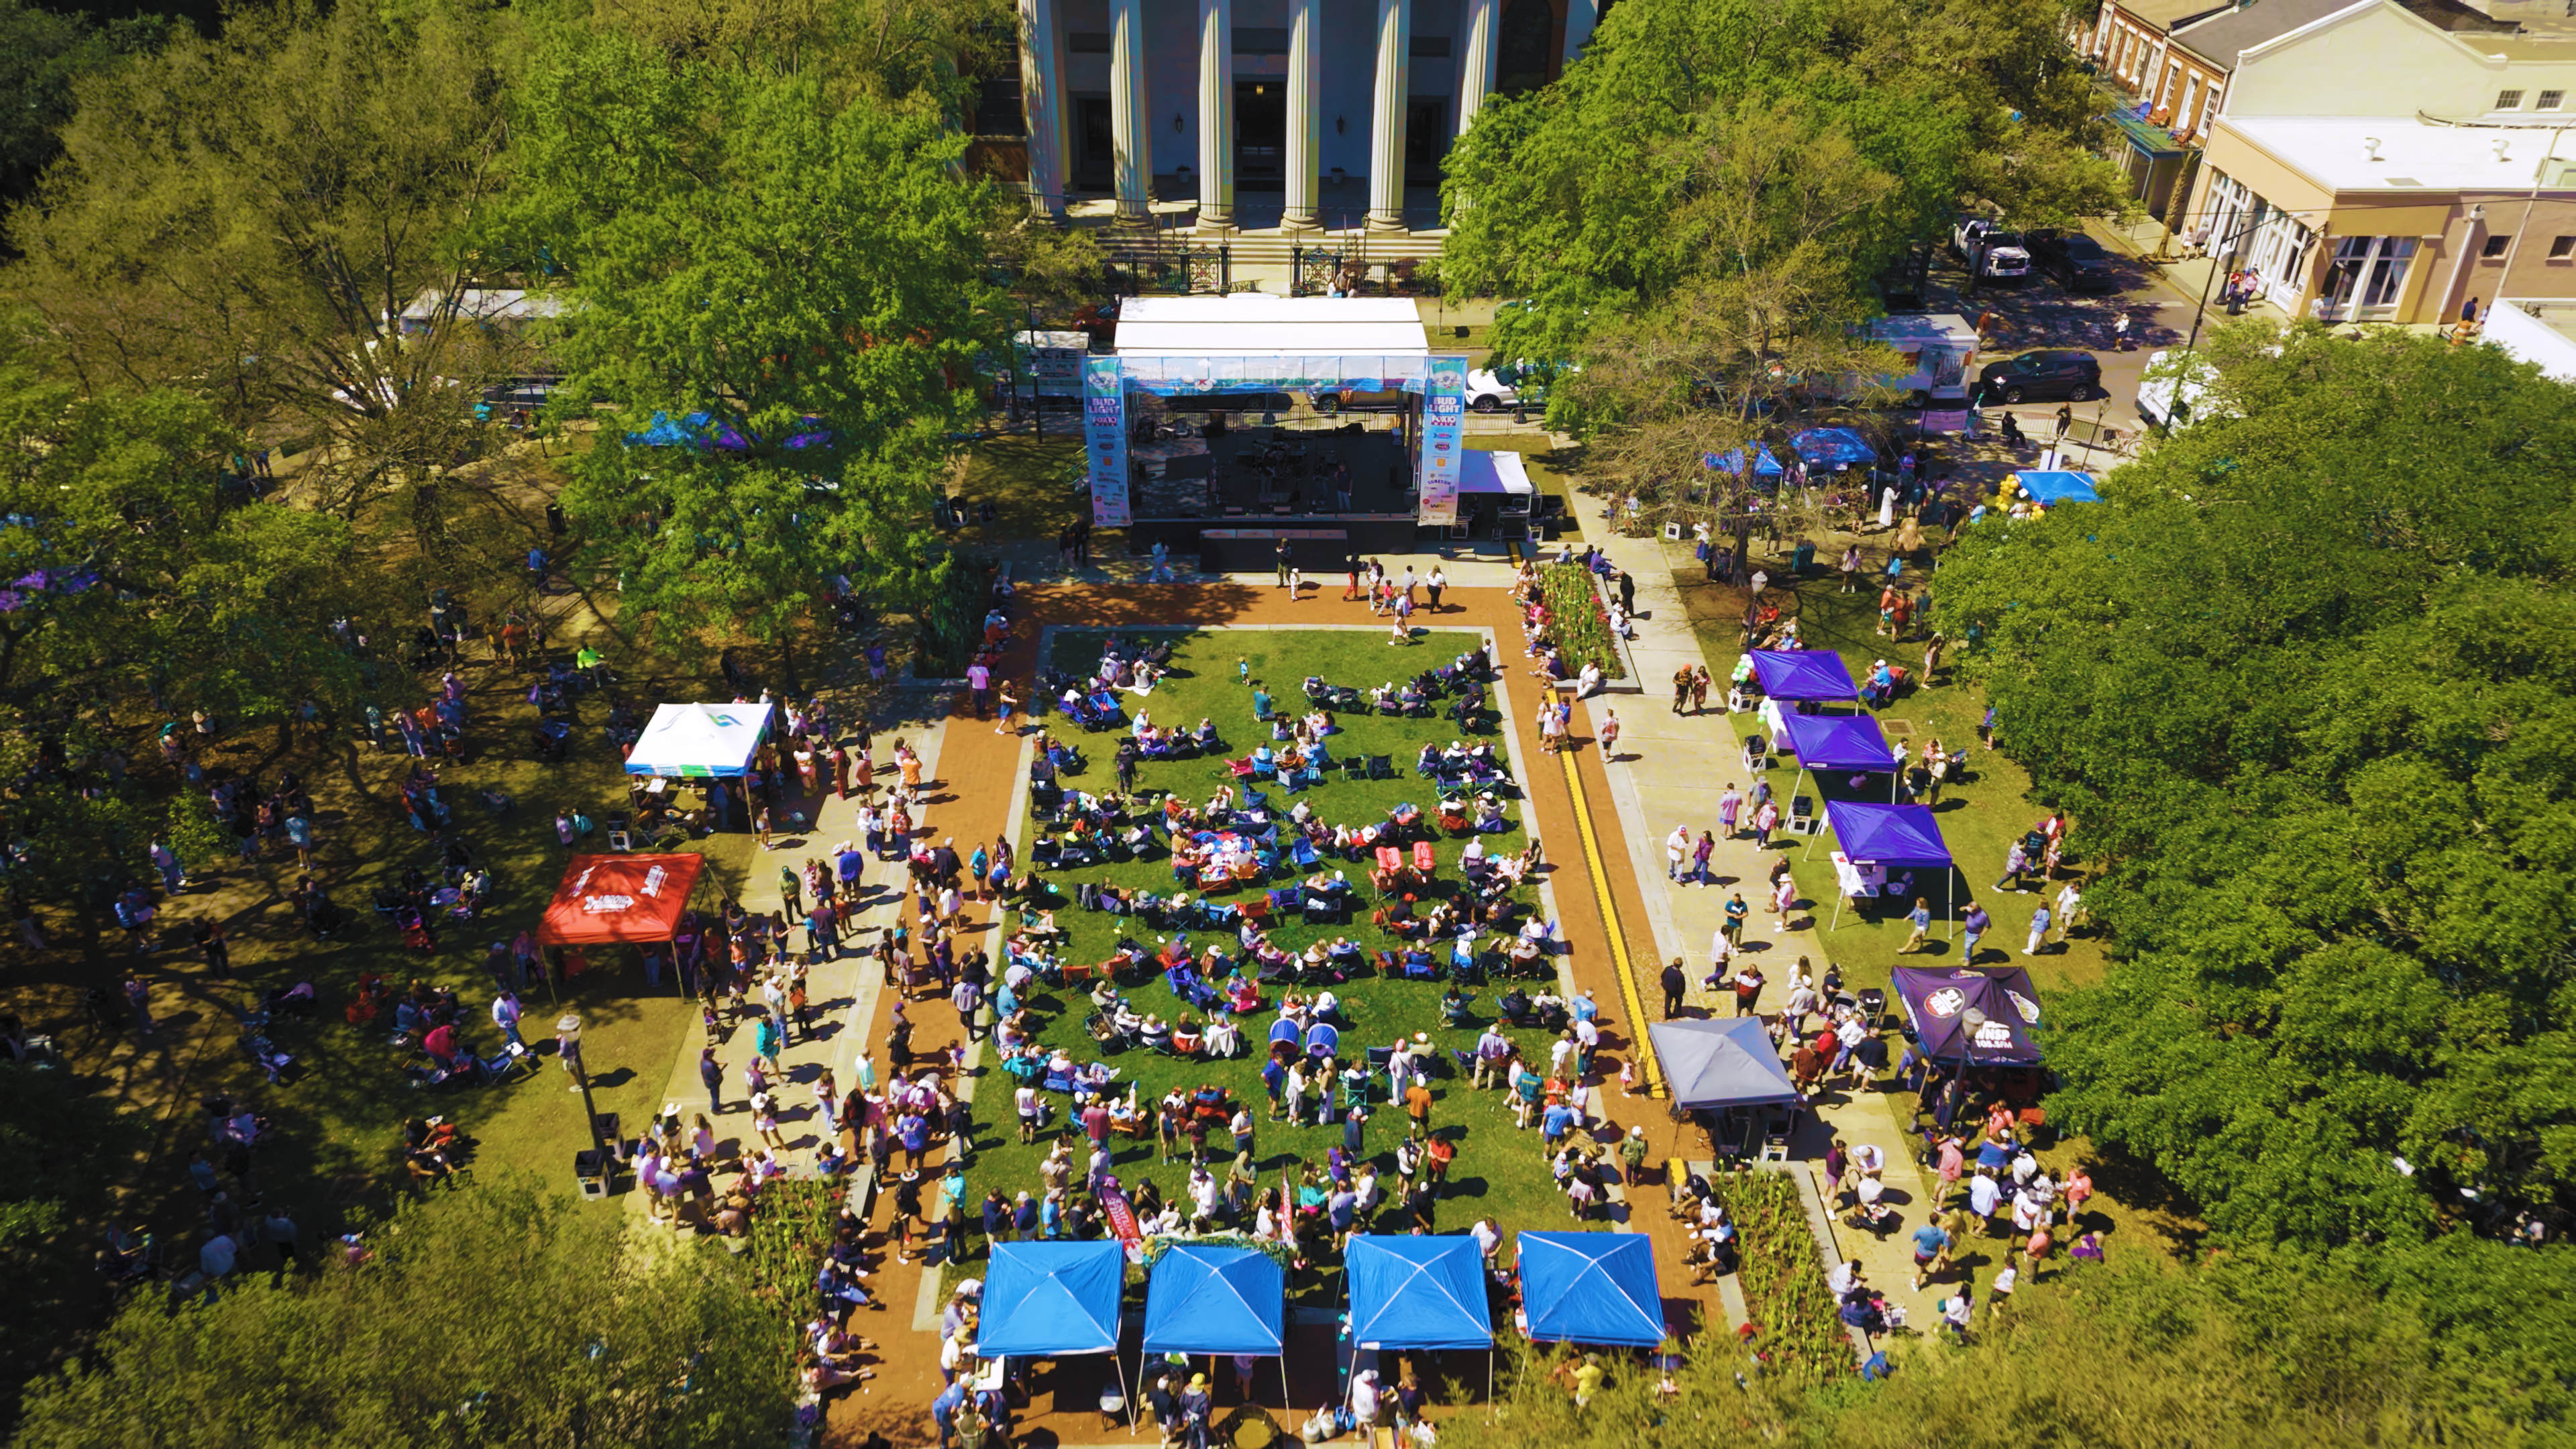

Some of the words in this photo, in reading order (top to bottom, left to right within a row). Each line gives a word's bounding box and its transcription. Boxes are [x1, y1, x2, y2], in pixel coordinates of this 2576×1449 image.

[1092, 398, 1116, 406] BUD
[1434, 396, 1457, 405] BUD
[1429, 404, 1460, 413] LIGHT
[1975, 1026, 2010, 1040] WNSP
